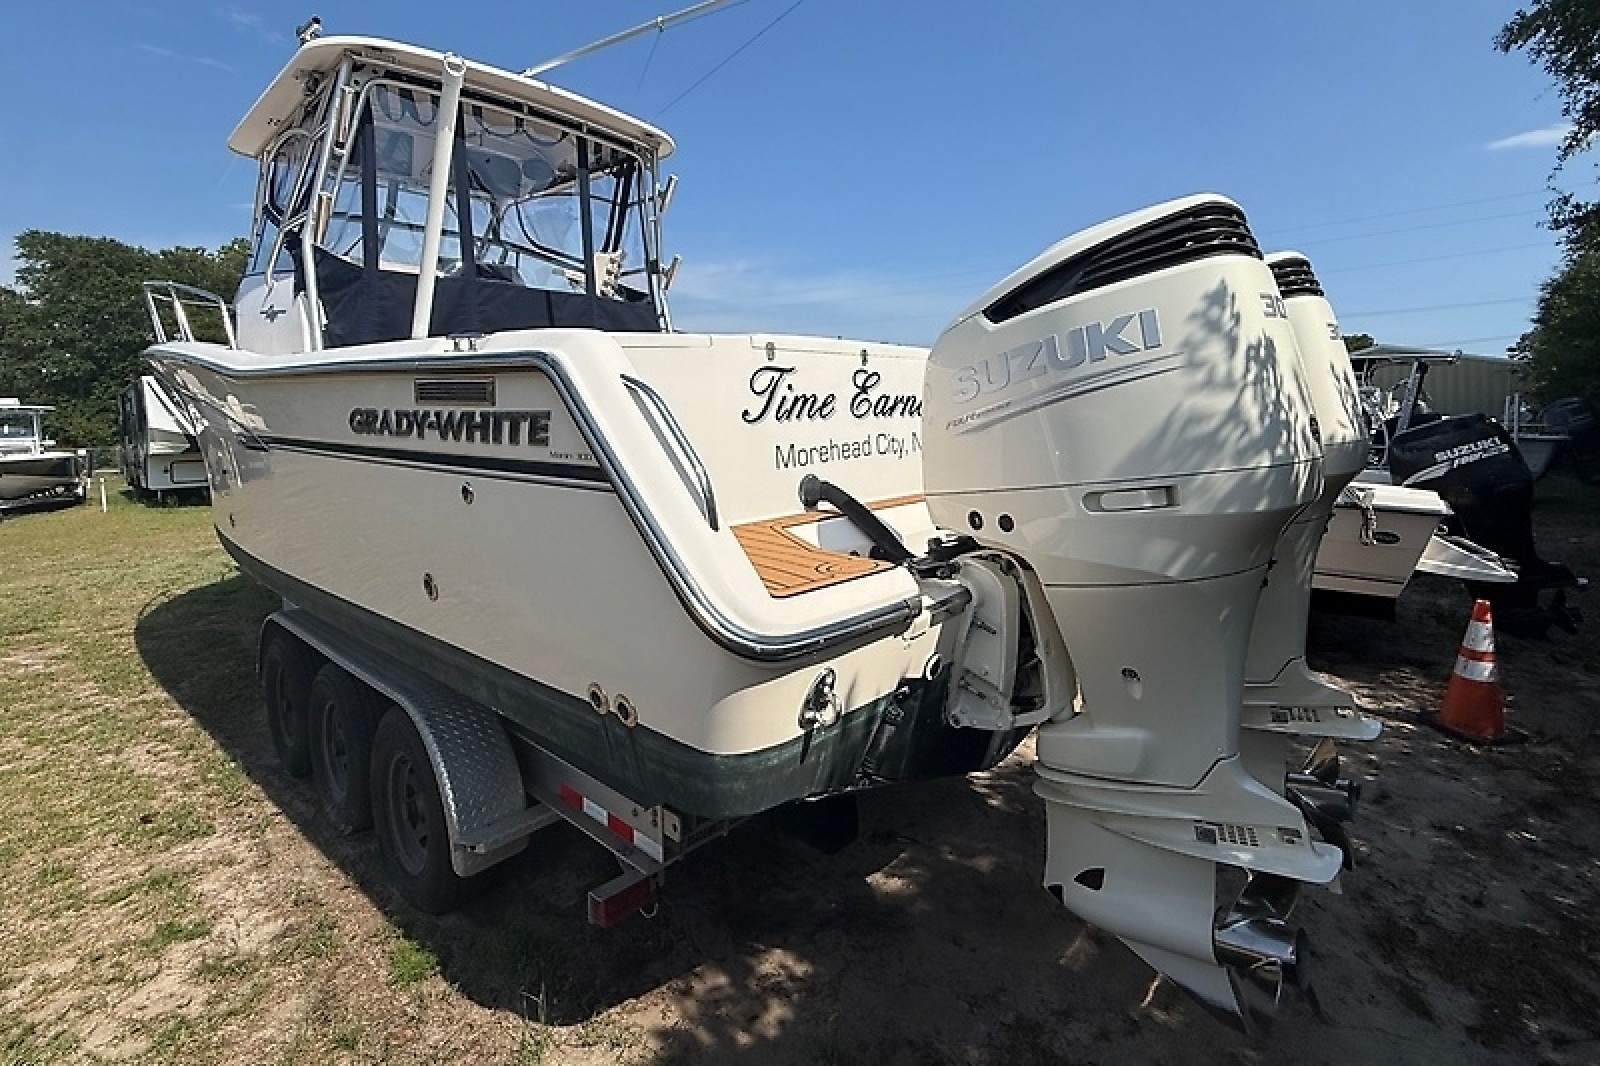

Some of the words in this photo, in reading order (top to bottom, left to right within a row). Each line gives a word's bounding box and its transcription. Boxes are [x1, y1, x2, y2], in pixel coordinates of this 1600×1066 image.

[951, 308, 1162, 403] SUZUKI
[742, 366, 837, 423] Time
[349, 407, 551, 446] GRADY-WHITE
[775, 433, 873, 470] Morehead
[875, 433, 909, 460] City,
